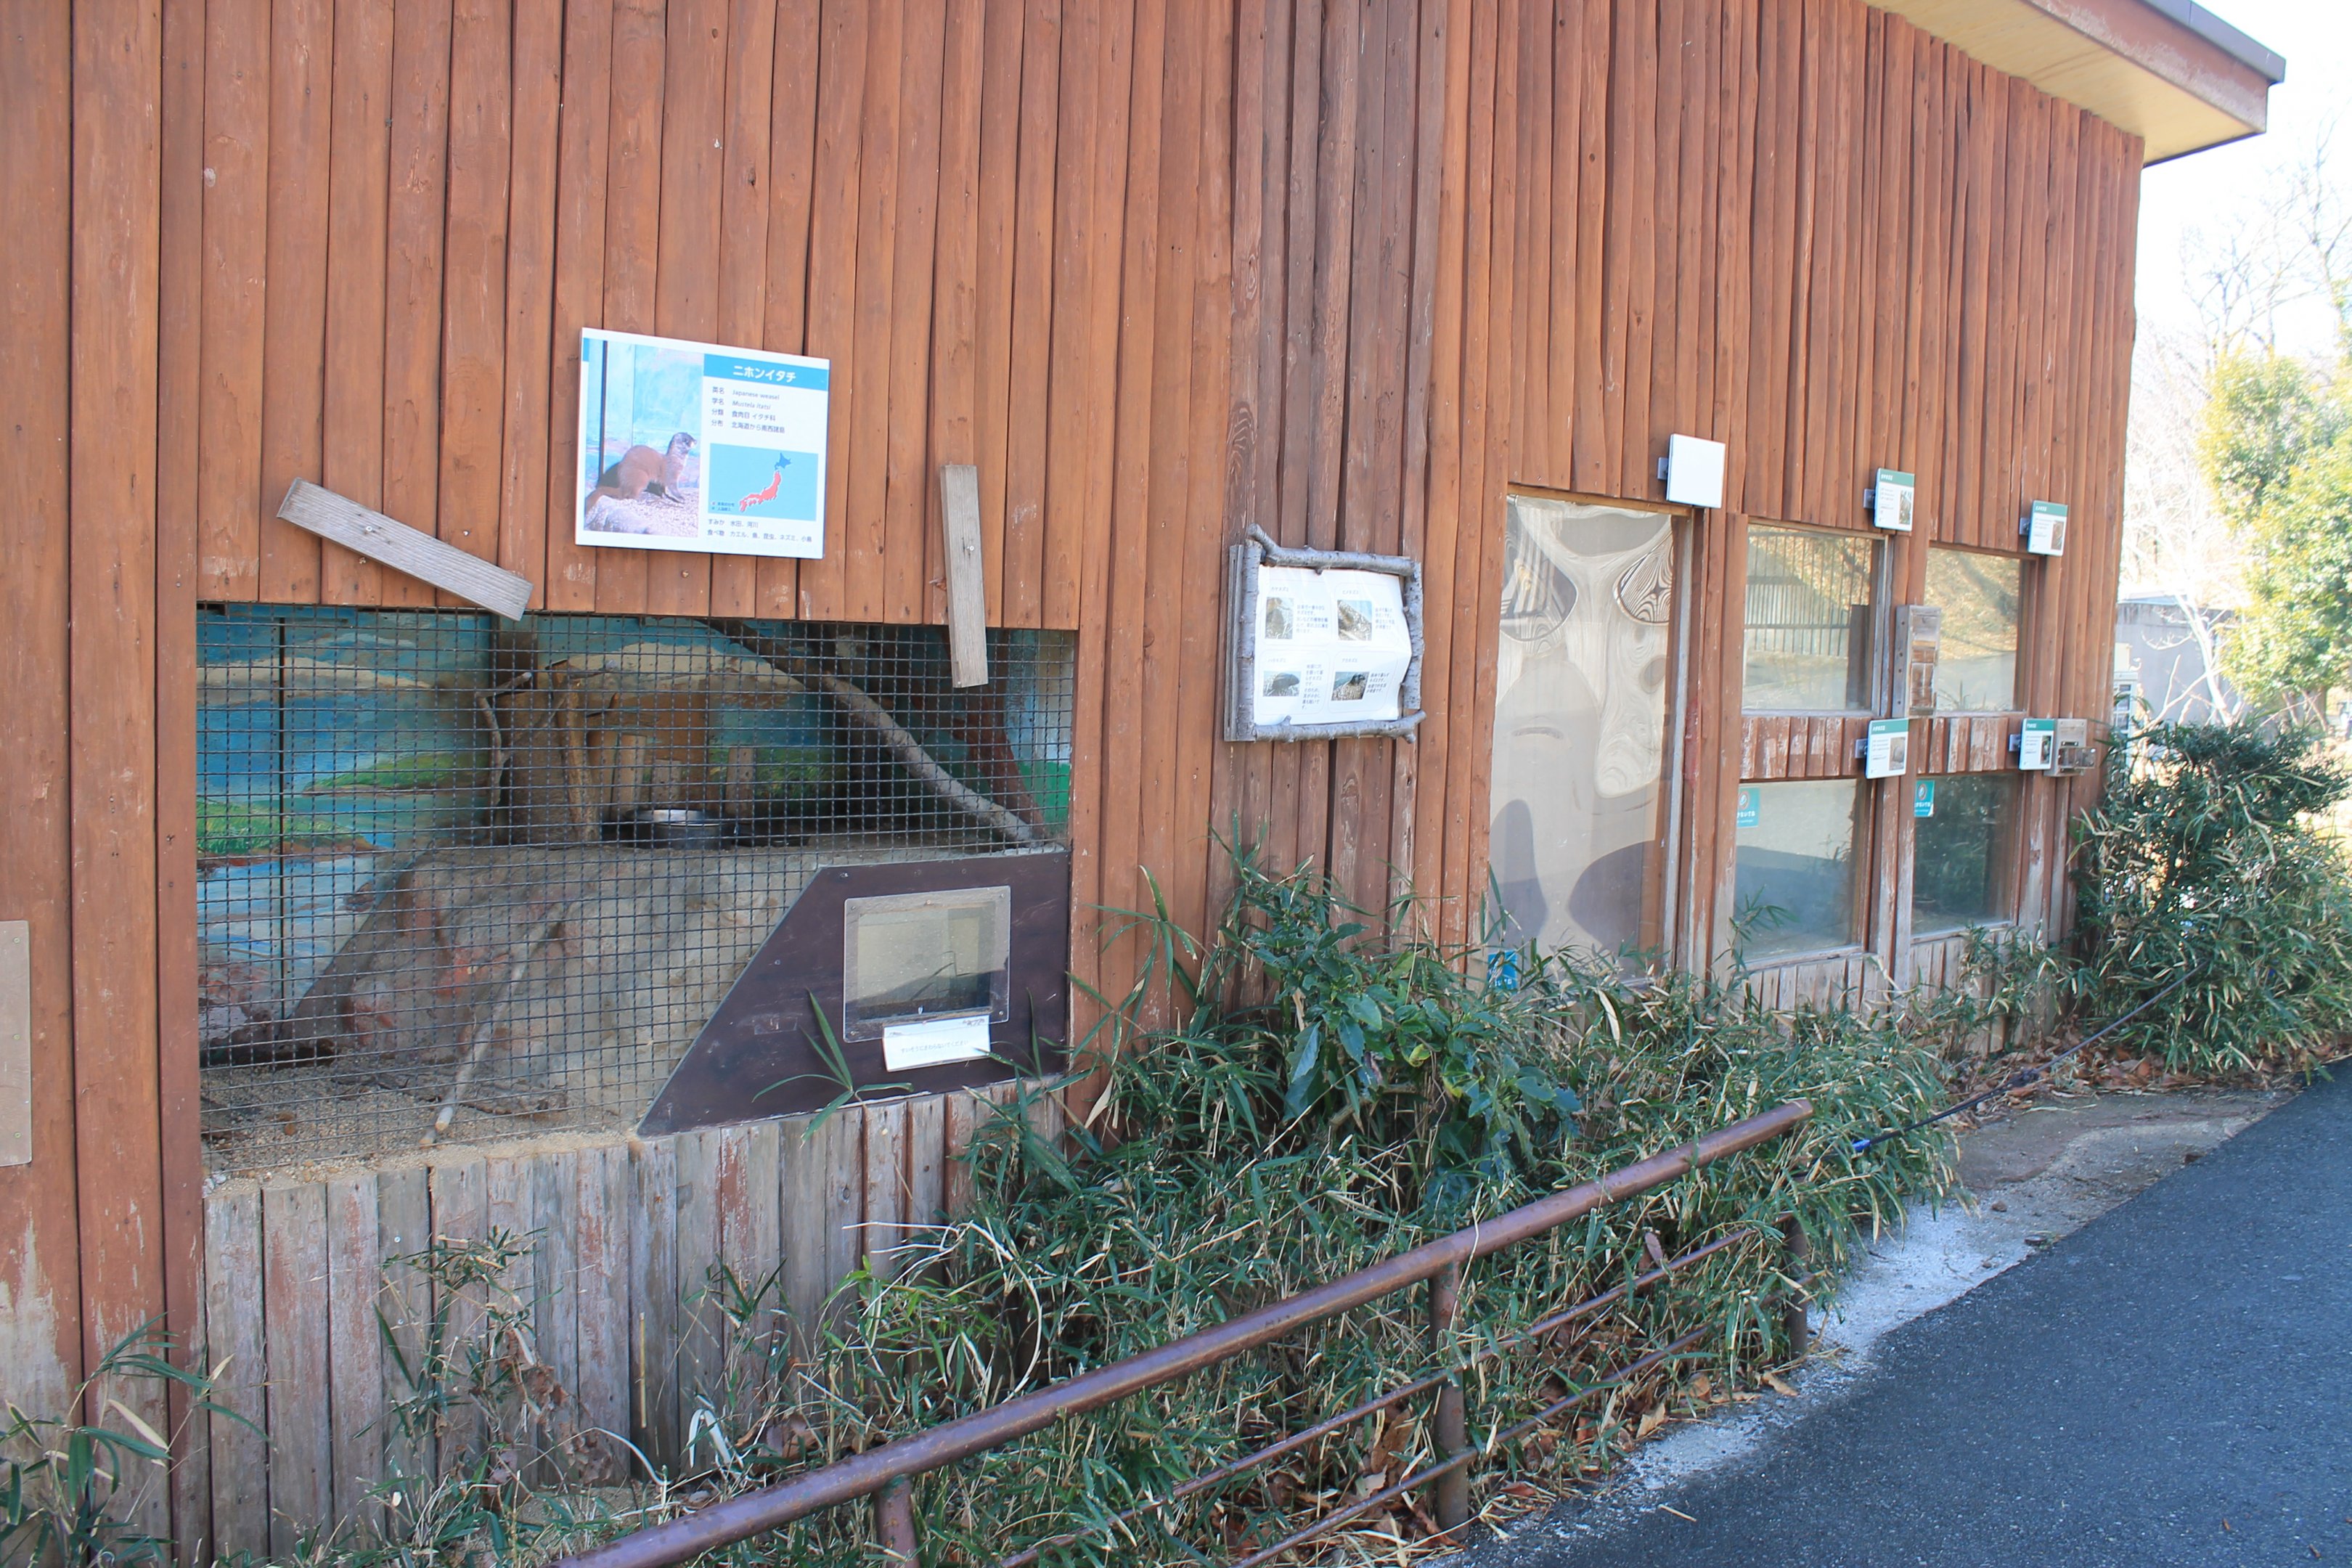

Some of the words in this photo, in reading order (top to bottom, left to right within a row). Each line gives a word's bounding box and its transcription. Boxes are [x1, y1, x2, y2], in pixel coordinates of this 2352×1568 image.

[732, 365, 796, 383] ニホンイタチ
[732, 390, 759, 399] Japanese
